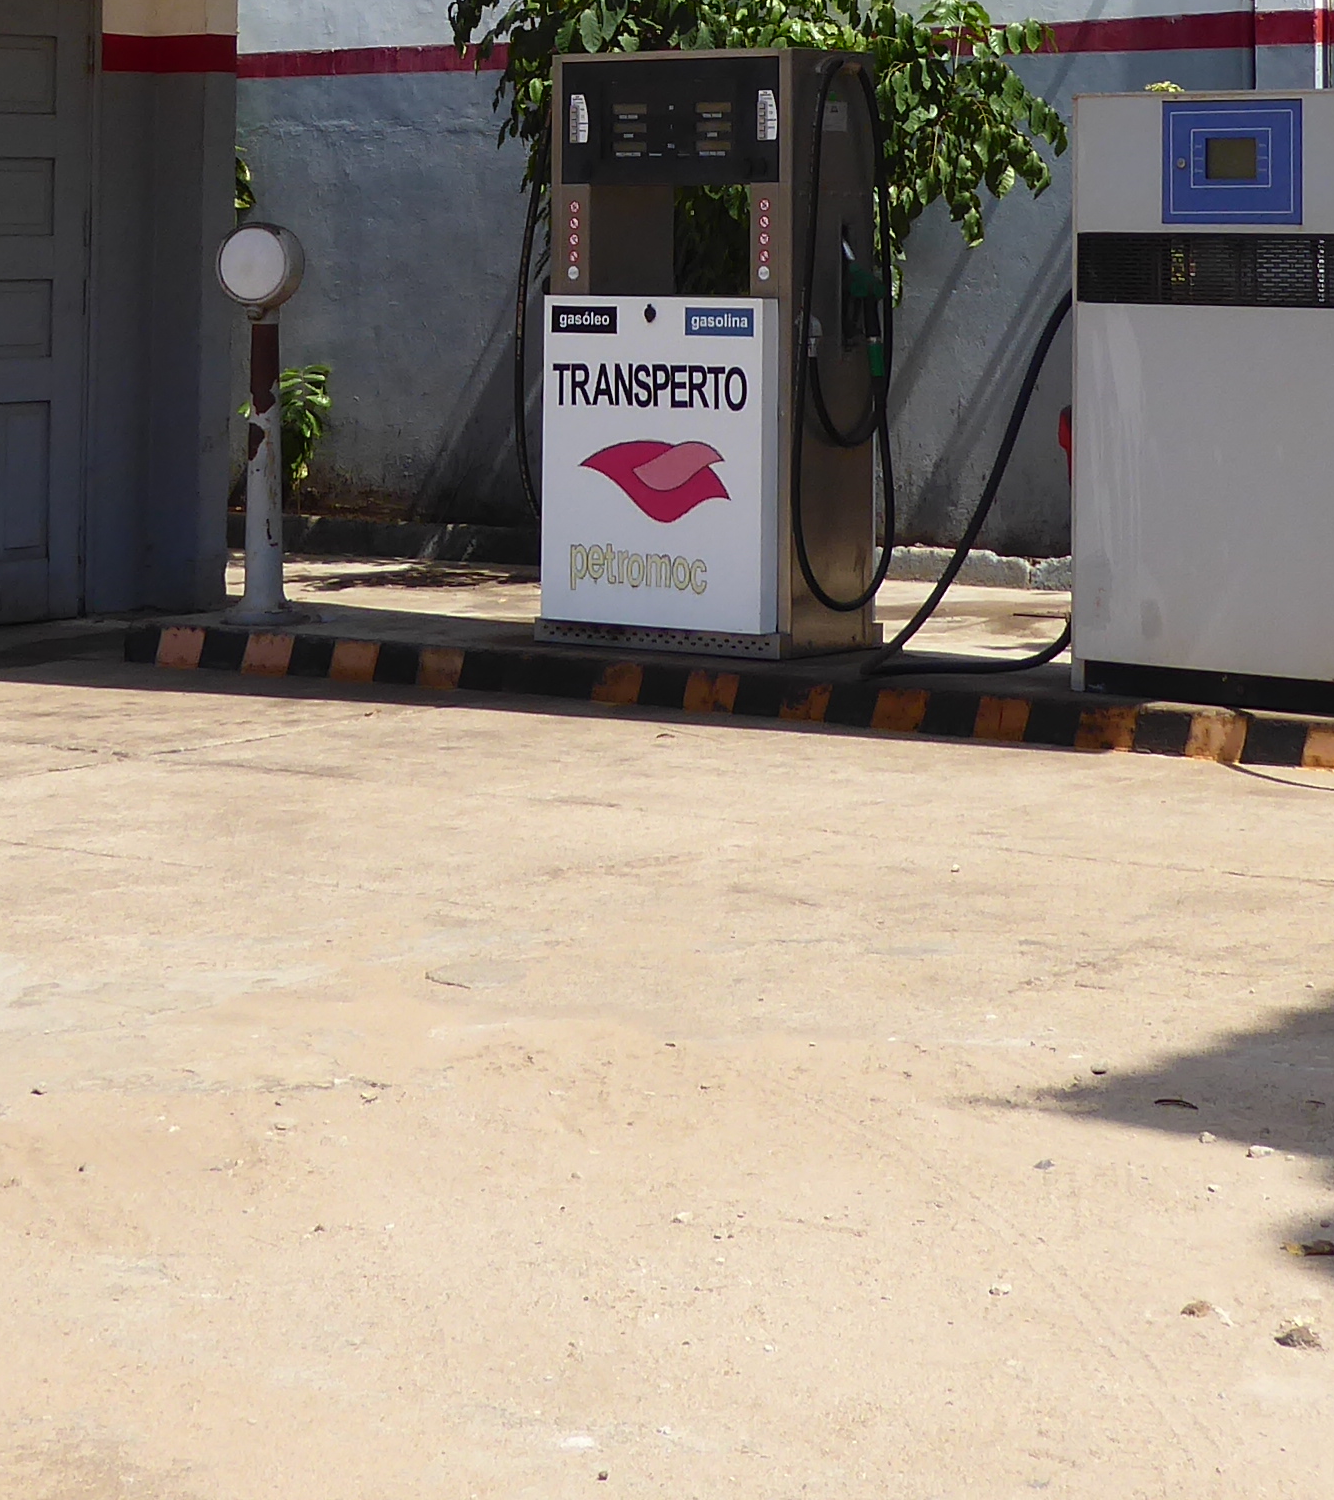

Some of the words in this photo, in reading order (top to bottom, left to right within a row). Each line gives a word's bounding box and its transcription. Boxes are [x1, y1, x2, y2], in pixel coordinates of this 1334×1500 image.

[559, 311, 610, 328] gasóleo
[691, 314, 748, 331] gasolina
[552, 363, 748, 412] TRANSPERTO
[569, 541, 708, 595] petromoc
